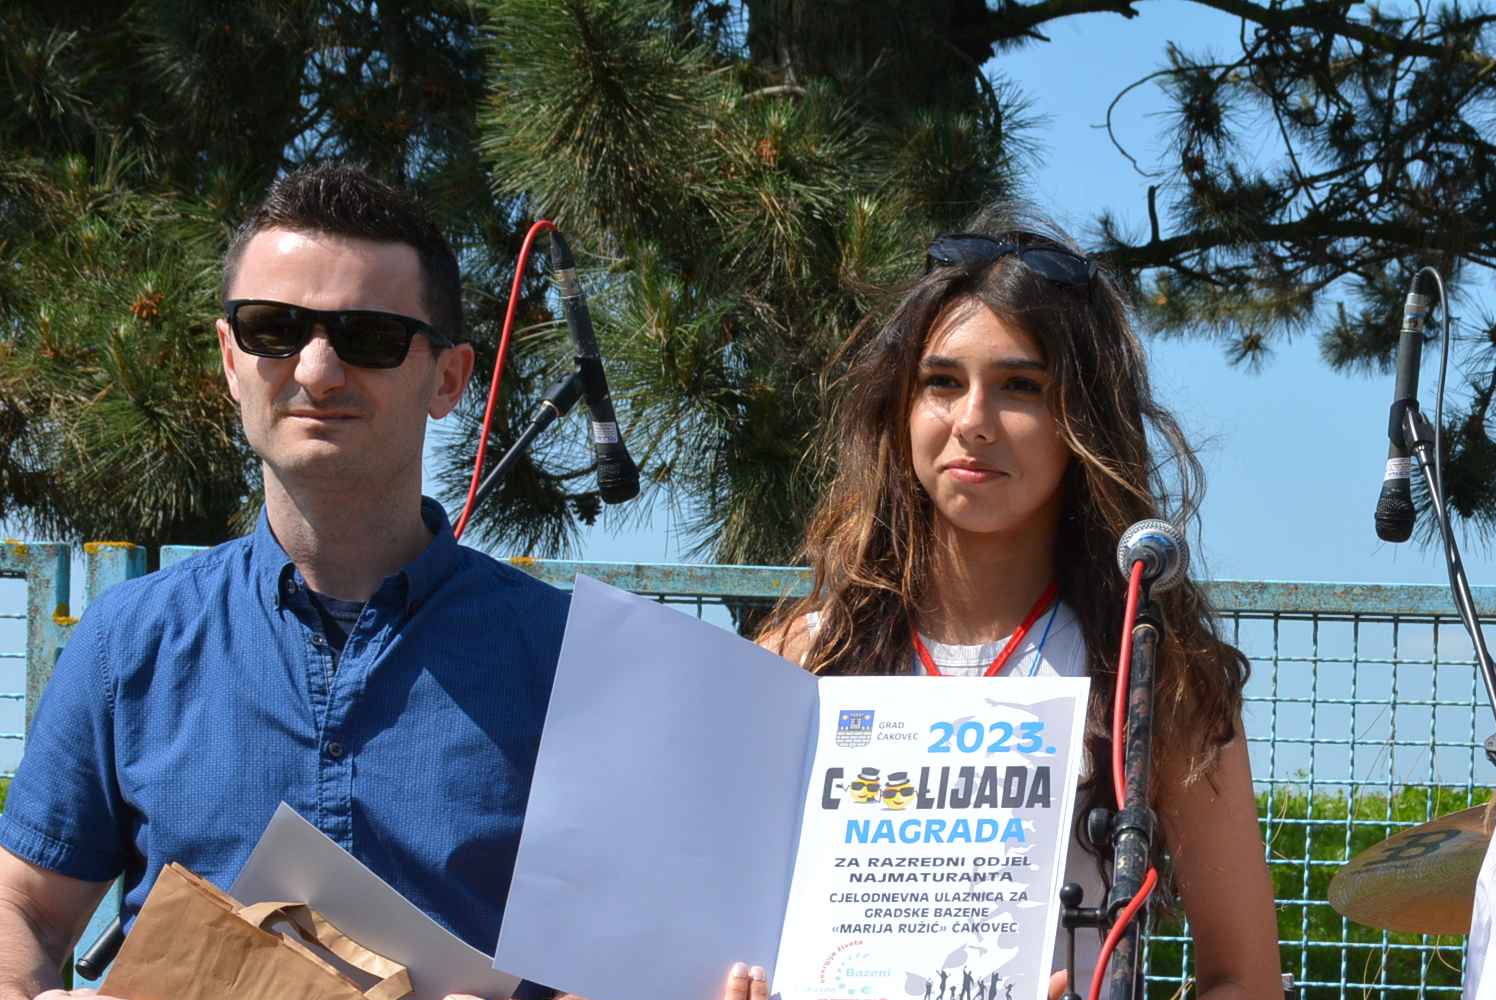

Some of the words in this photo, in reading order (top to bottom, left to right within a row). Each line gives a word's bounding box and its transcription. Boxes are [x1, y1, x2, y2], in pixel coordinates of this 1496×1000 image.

[878, 721, 905, 730] GRAD
[877, 731, 919, 742] ČAKOVEC
[927, 720, 1057, 754] 2023.
[845, 817, 1026, 844] NAGRADA
[834, 857, 860, 867] ZA
[867, 857, 966, 867] RAZREDNI
[972, 856, 1031, 867] ODJEL
[849, 872, 1014, 883] NAJMATURANTA
[829, 892, 930, 903] CJELODNEVNA
[934, 891, 1004, 903] ULAZNICA
[1009, 891, 1029, 902] ZA
[864, 908, 929, 918] GRADSKE
[933, 907, 990, 918] BAZENE
[952, 920, 1018, 933] ČAKOVEC
